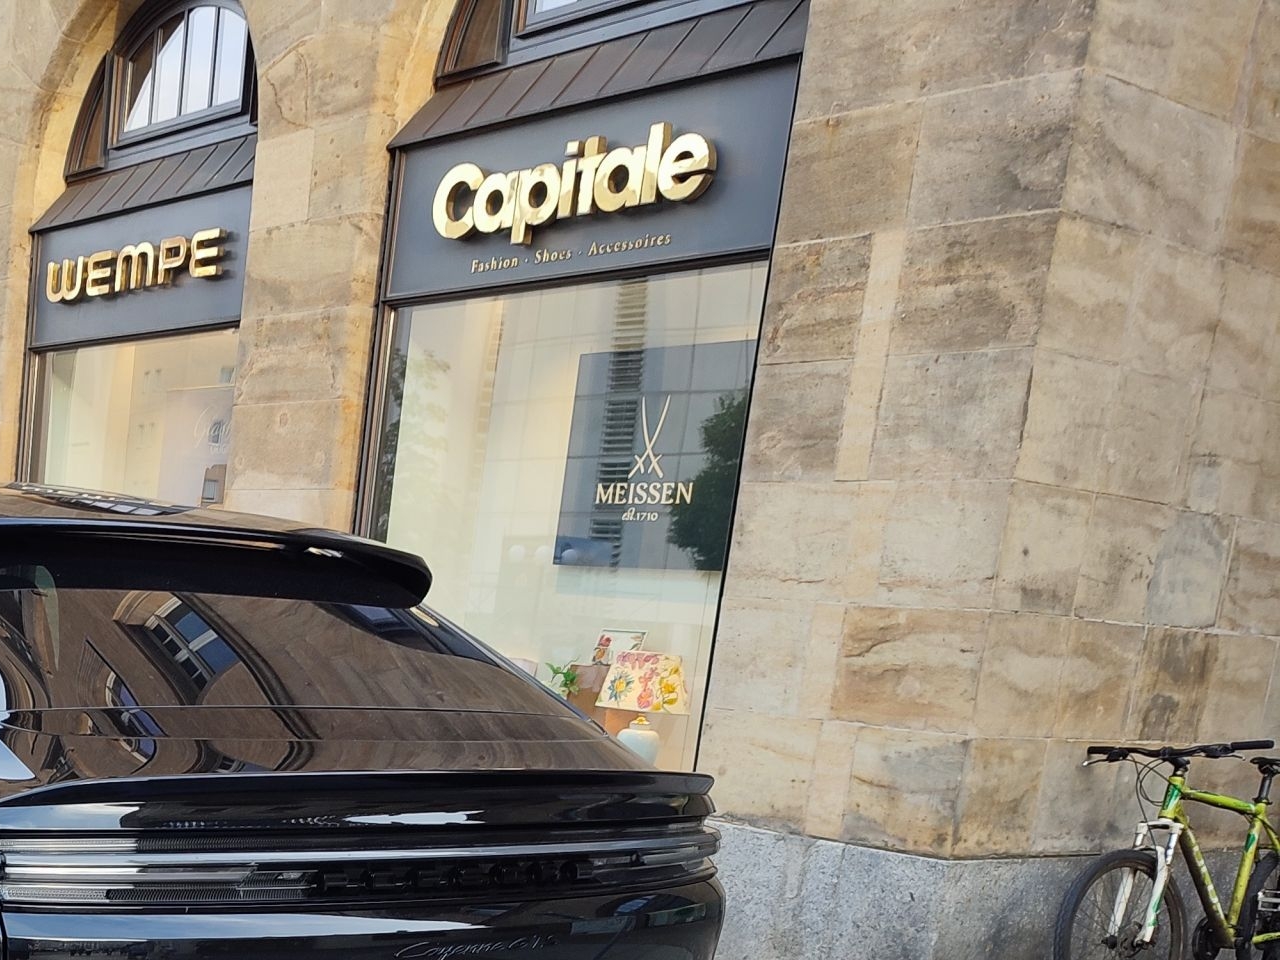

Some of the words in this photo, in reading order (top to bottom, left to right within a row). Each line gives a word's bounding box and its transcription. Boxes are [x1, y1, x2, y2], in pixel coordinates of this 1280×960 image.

[432, 120, 716, 245] Capitale
[46, 227, 226, 303] WEMPE
[471, 254, 519, 274] Fashion
[534, 249, 572, 265] Shoes
[588, 233, 671, 257] Accessoires
[595, 482, 694, 505] MEISSEN
